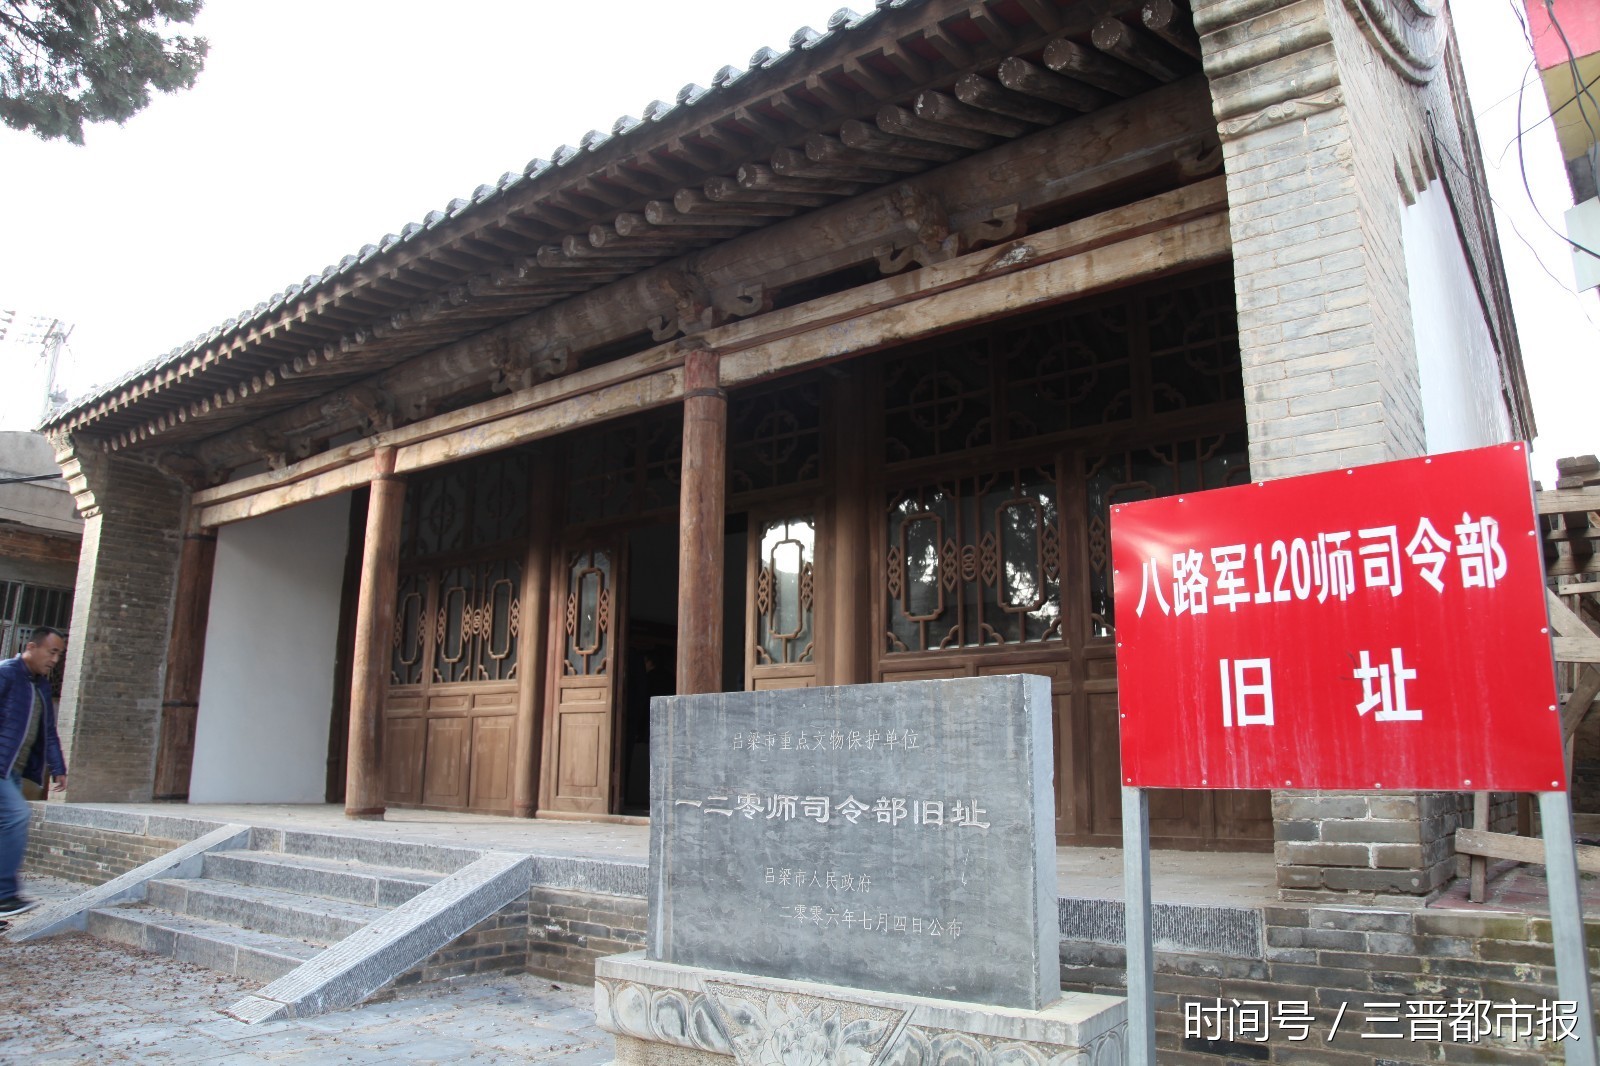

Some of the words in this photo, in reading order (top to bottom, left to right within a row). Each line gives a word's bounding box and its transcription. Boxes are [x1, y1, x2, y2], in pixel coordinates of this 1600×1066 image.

[1136, 512, 1508, 617] 八路军120师司令部
[732, 729, 921, 751] 吕梁市重点文物保护单位
[675, 794, 991, 829] 一二零师司令部旧址
[764, 867, 872, 893] 吕梁市人民政府
[780, 904, 962, 938] 二零零六年七月四日公布
